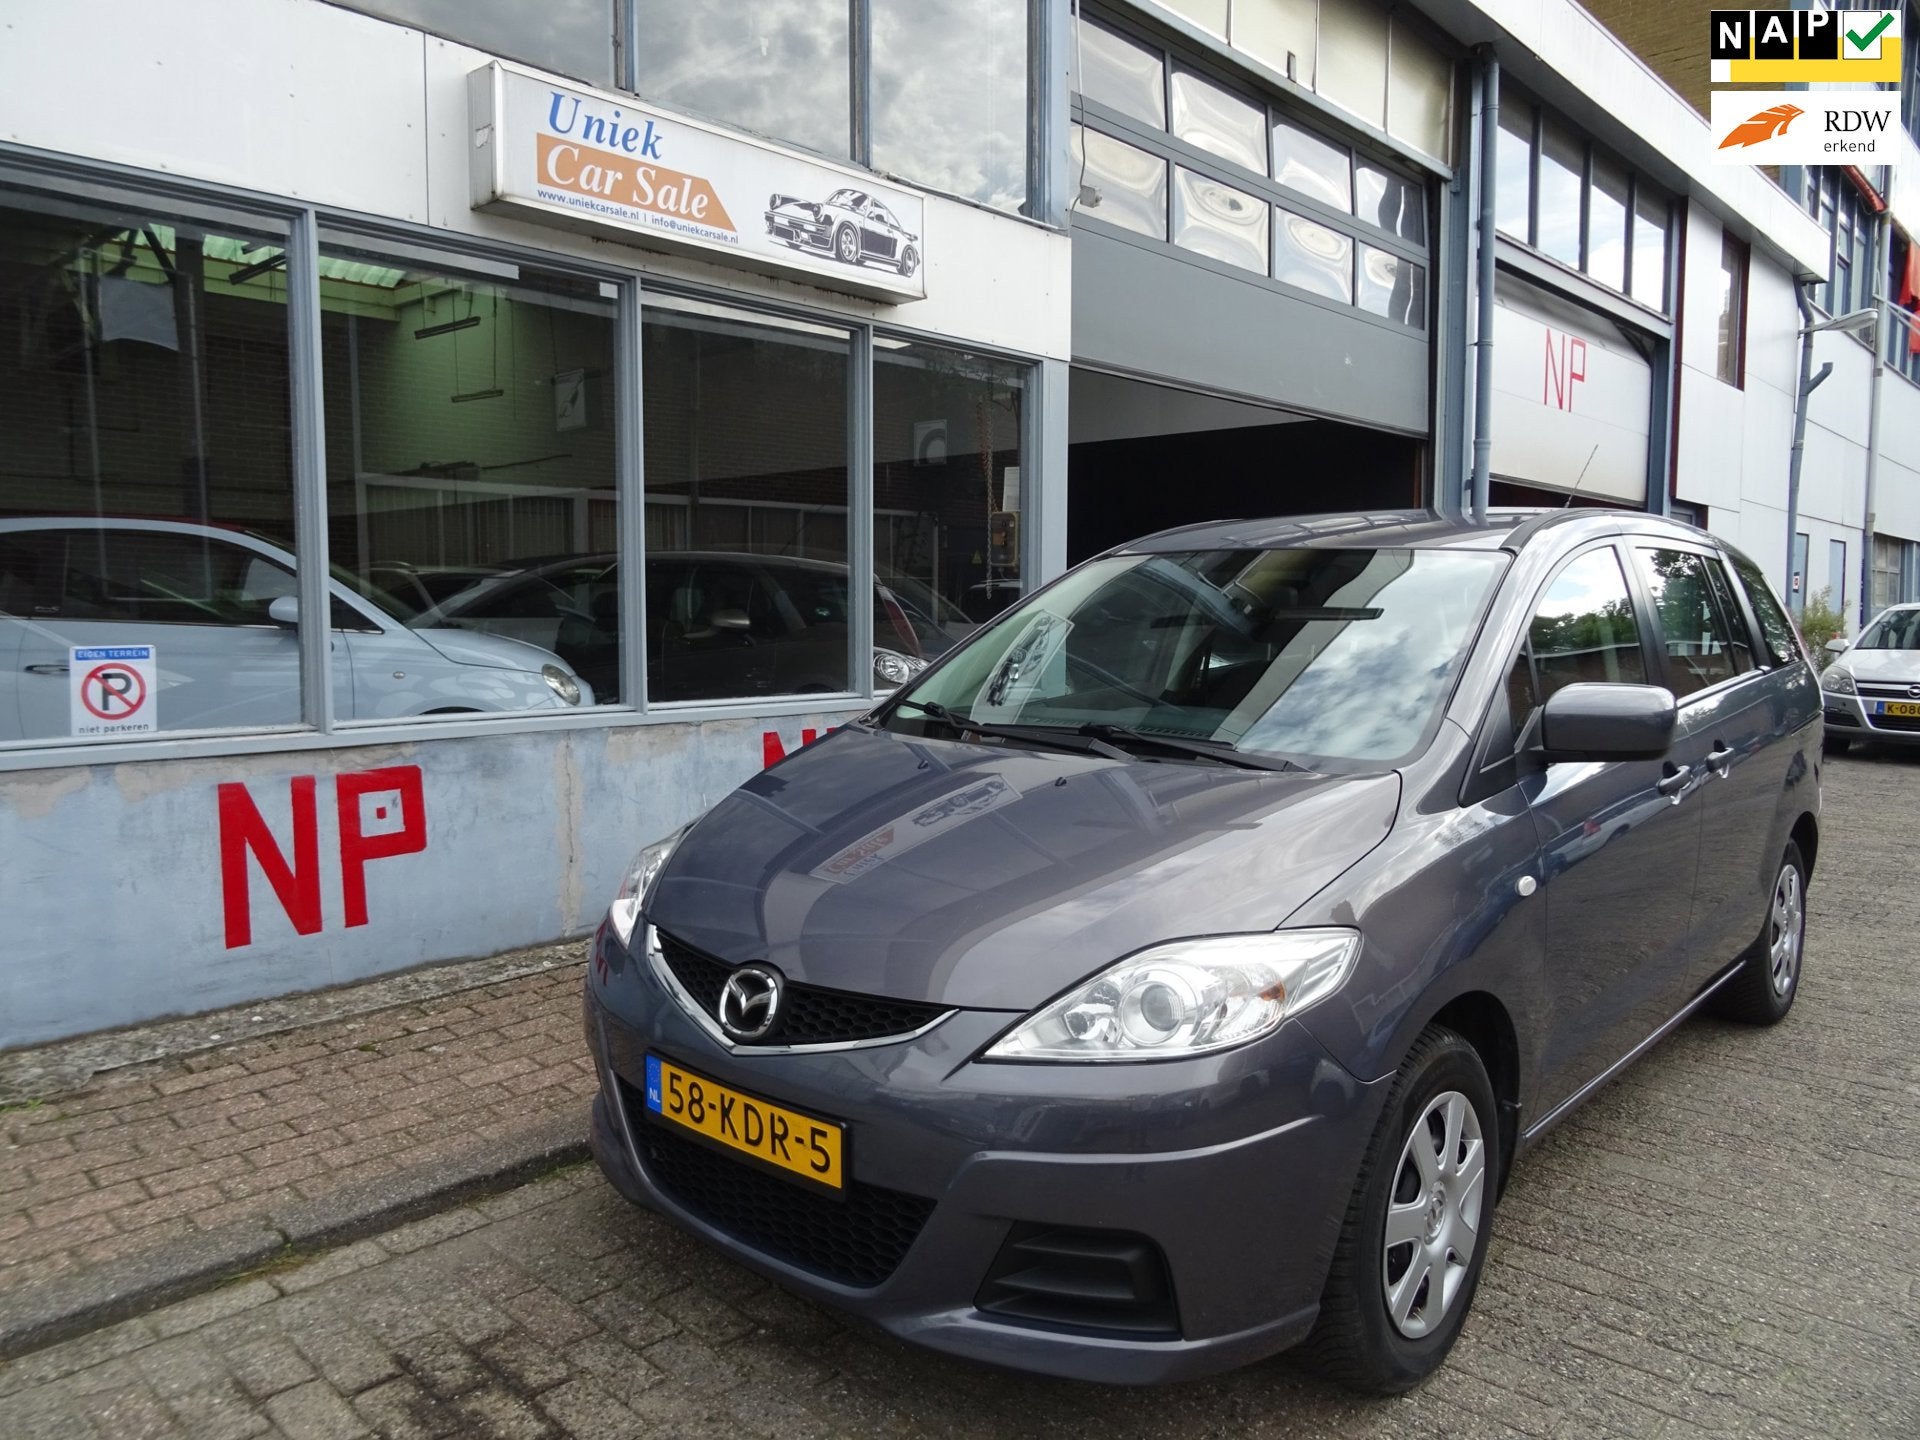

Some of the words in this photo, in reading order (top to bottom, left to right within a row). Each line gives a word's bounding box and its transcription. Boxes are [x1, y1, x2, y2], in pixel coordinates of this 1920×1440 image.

[548, 91, 663, 160] Uniek
[547, 144, 623, 196] Car
[632, 165, 708, 219] Sale
[537, 189, 639, 220] www.uniekcarsale.nl
[651, 214, 739, 244] info@uniekcarsale.nl
[1544, 327, 1586, 413] NP
[77, 650, 106, 658] EIGEN
[108, 649, 148, 657] TERREIN
[79, 725, 100, 734] niet
[103, 723, 150, 733] parkeren
[217, 764, 427, 950] NP
[649, 1087, 661, 1104] NL
[669, 1071, 831, 1174] 58-KDR-5
